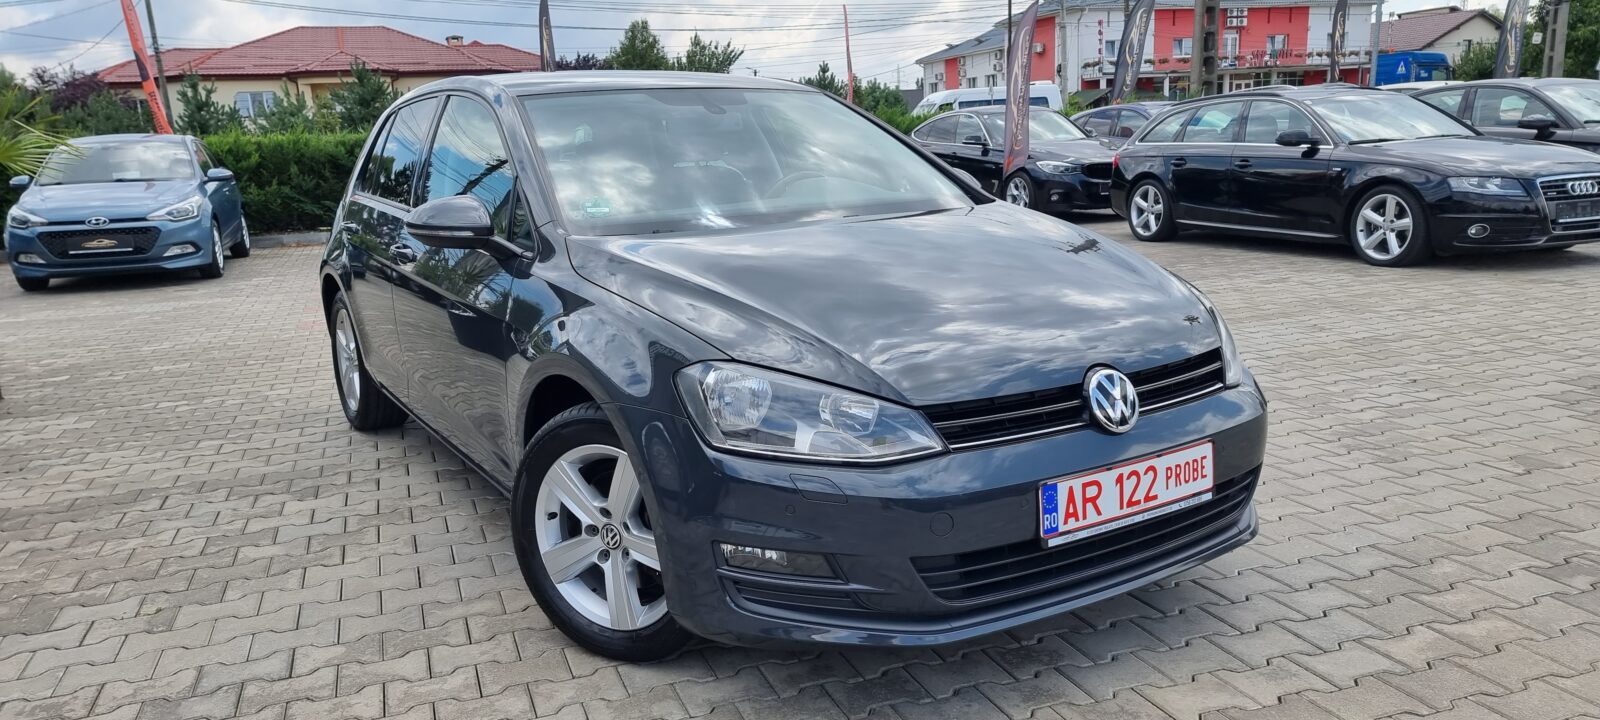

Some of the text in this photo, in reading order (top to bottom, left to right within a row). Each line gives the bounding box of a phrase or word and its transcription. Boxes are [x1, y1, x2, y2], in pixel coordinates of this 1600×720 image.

[1063, 479, 1103, 526] AR
[1115, 465, 1159, 511] 122
[1165, 455, 1208, 490] PROBE
[1044, 512, 1059, 530] RO
